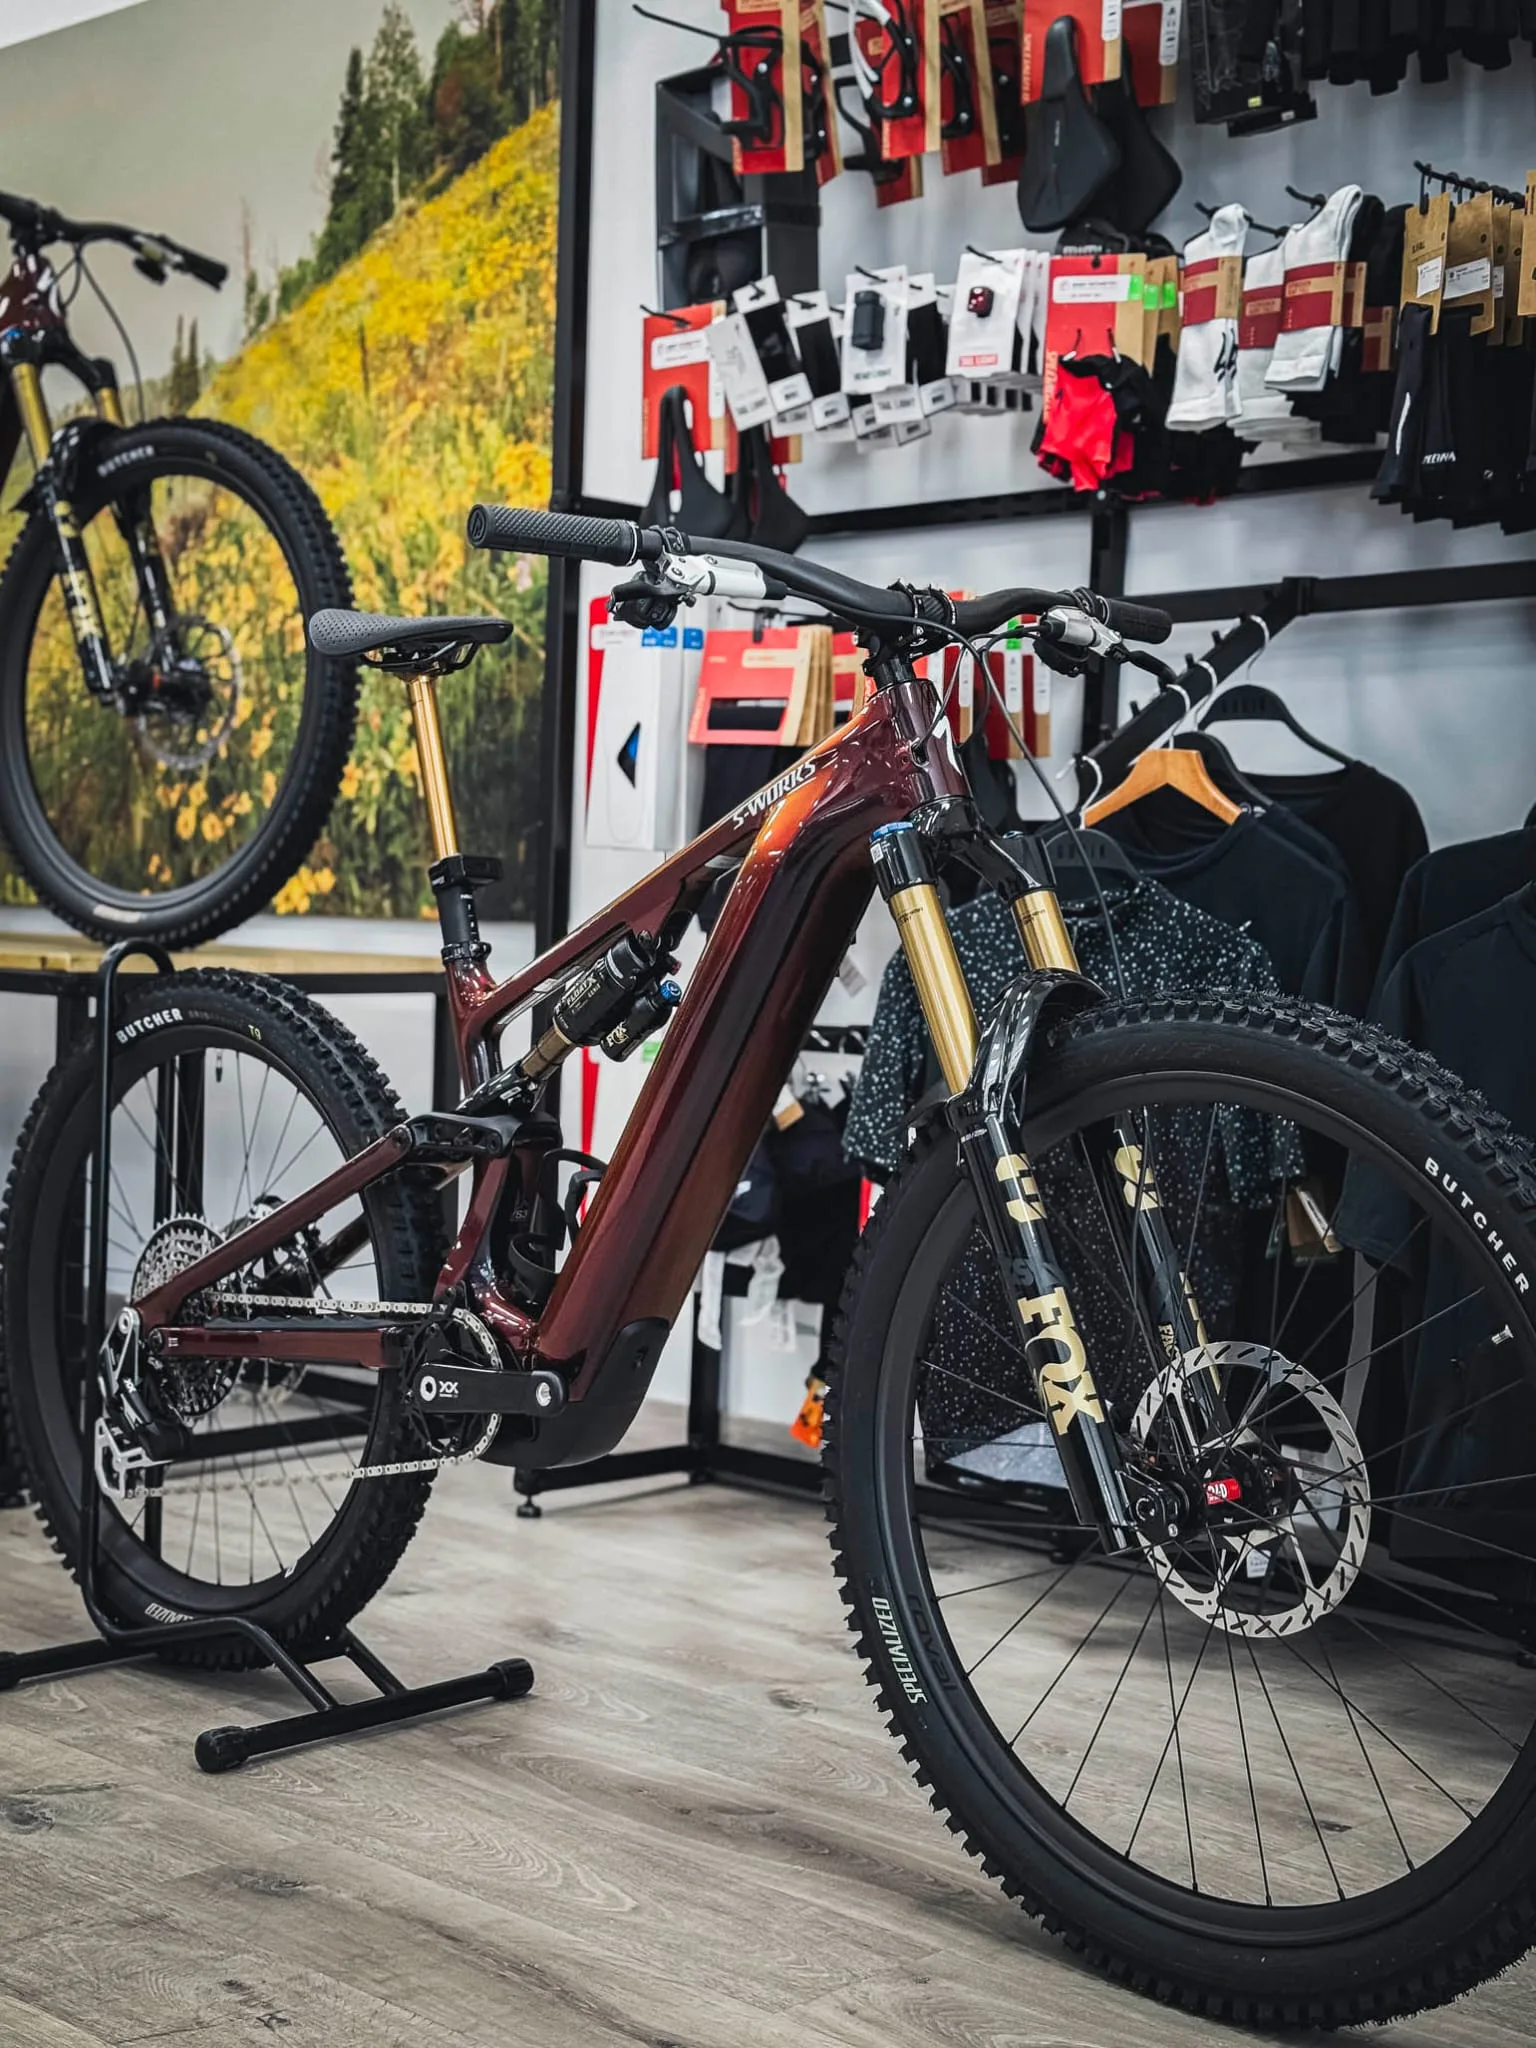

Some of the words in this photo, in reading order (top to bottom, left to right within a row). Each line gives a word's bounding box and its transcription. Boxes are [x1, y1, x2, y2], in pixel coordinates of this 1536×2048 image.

[732, 760, 816, 831] S-WORKS
[115, 1008, 184, 1044] BUTCHER
[605, 1017, 630, 1047] FOX
[1424, 1156, 1530, 1294] BUTCHER
[439, 1381, 459, 1394] XX
[1016, 1286, 1105, 1436] FOX
[872, 1597, 928, 1704] SPECIALIZED
